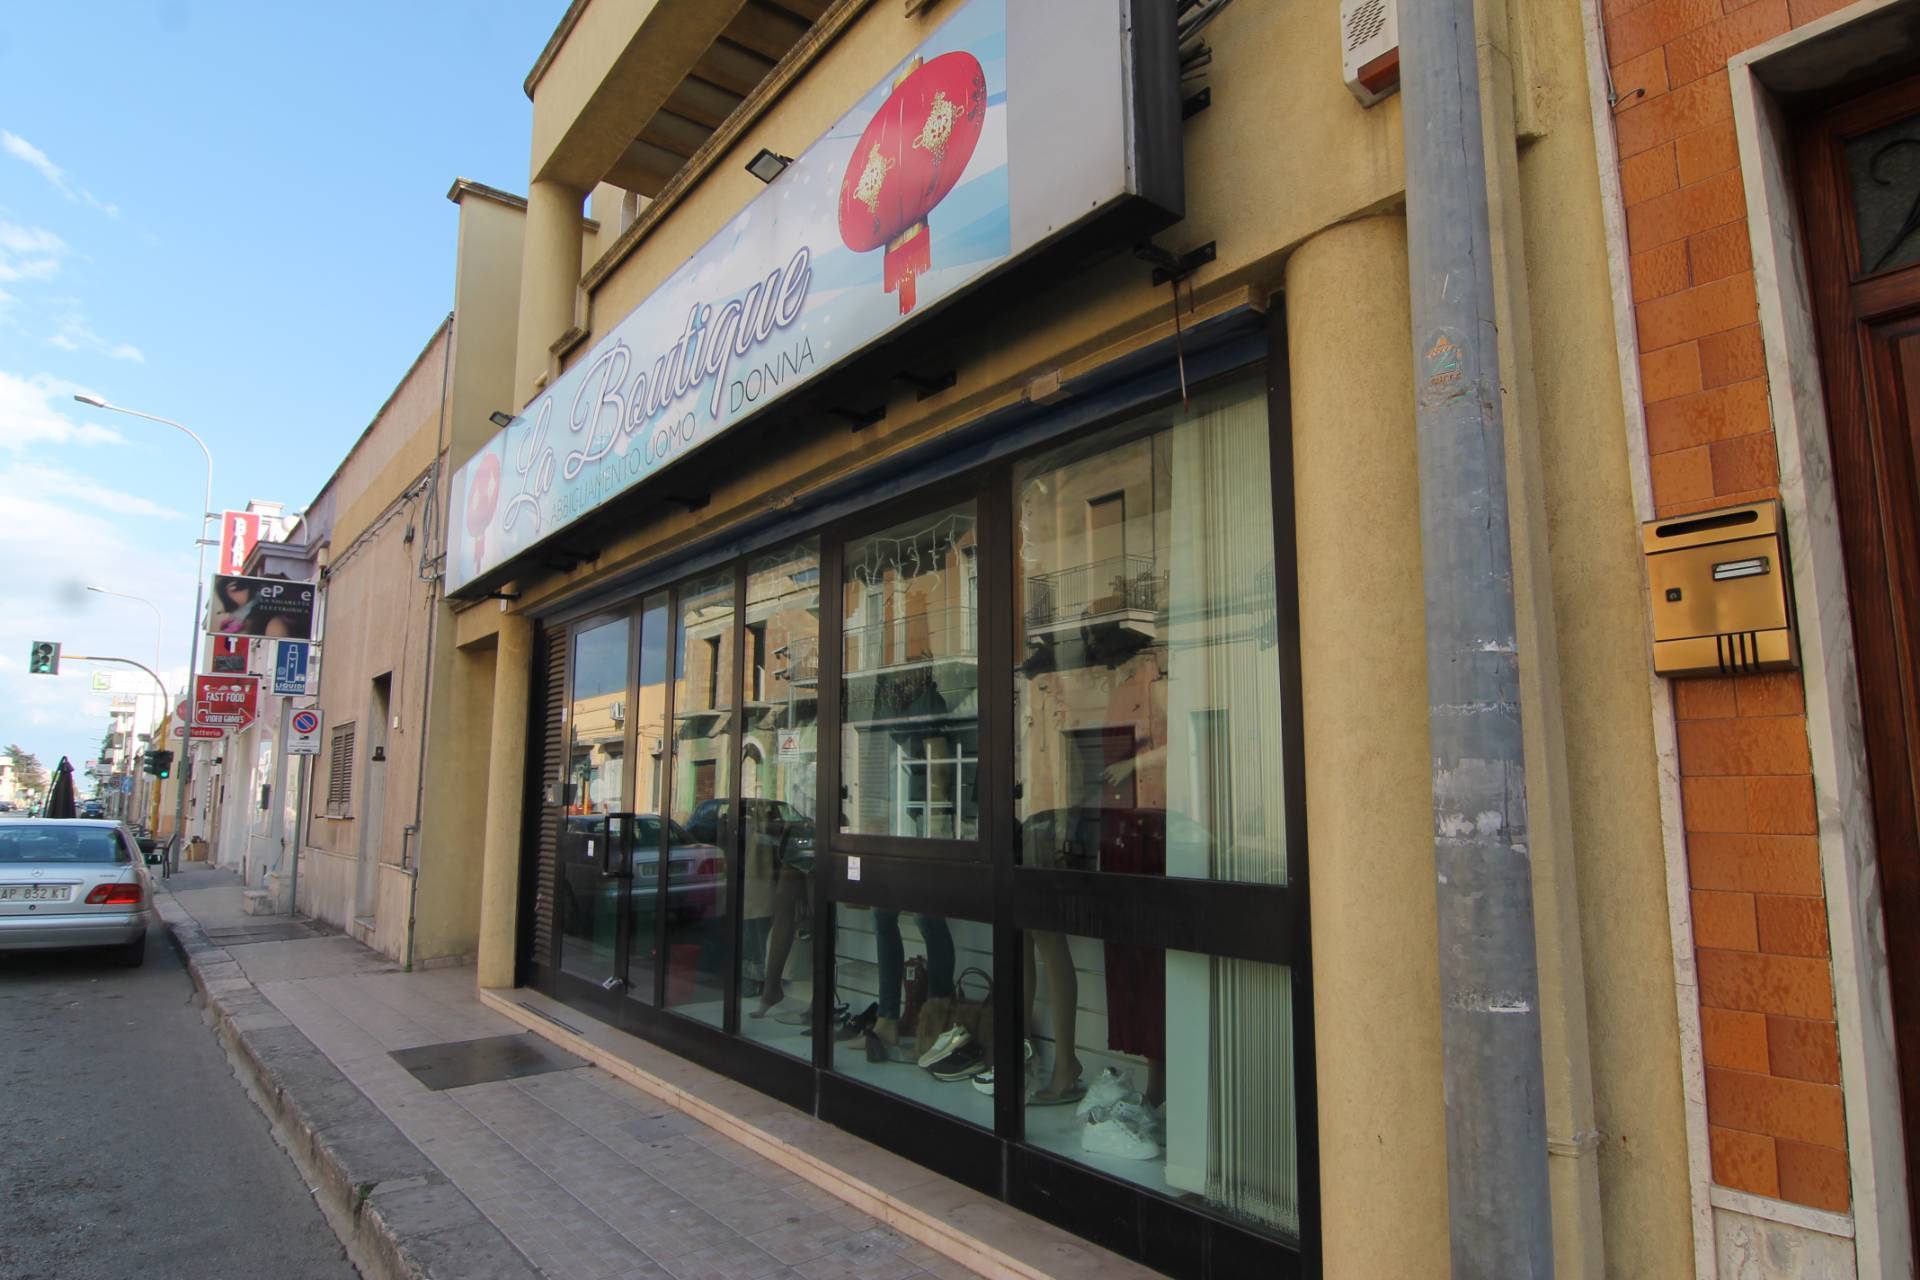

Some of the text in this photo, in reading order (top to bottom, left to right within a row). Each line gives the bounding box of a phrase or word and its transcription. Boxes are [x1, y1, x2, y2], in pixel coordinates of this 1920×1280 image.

[503, 246, 812, 533] La Boutique
[550, 337, 815, 521] ABBIGLIAMENTO UOMO DONNA
[206, 691, 246, 704] FAST FOOD
[205, 714, 245, 724] VIDEO GAMES
[25, 888, 47, 899] 832
[51, 888, 67, 899] KT
